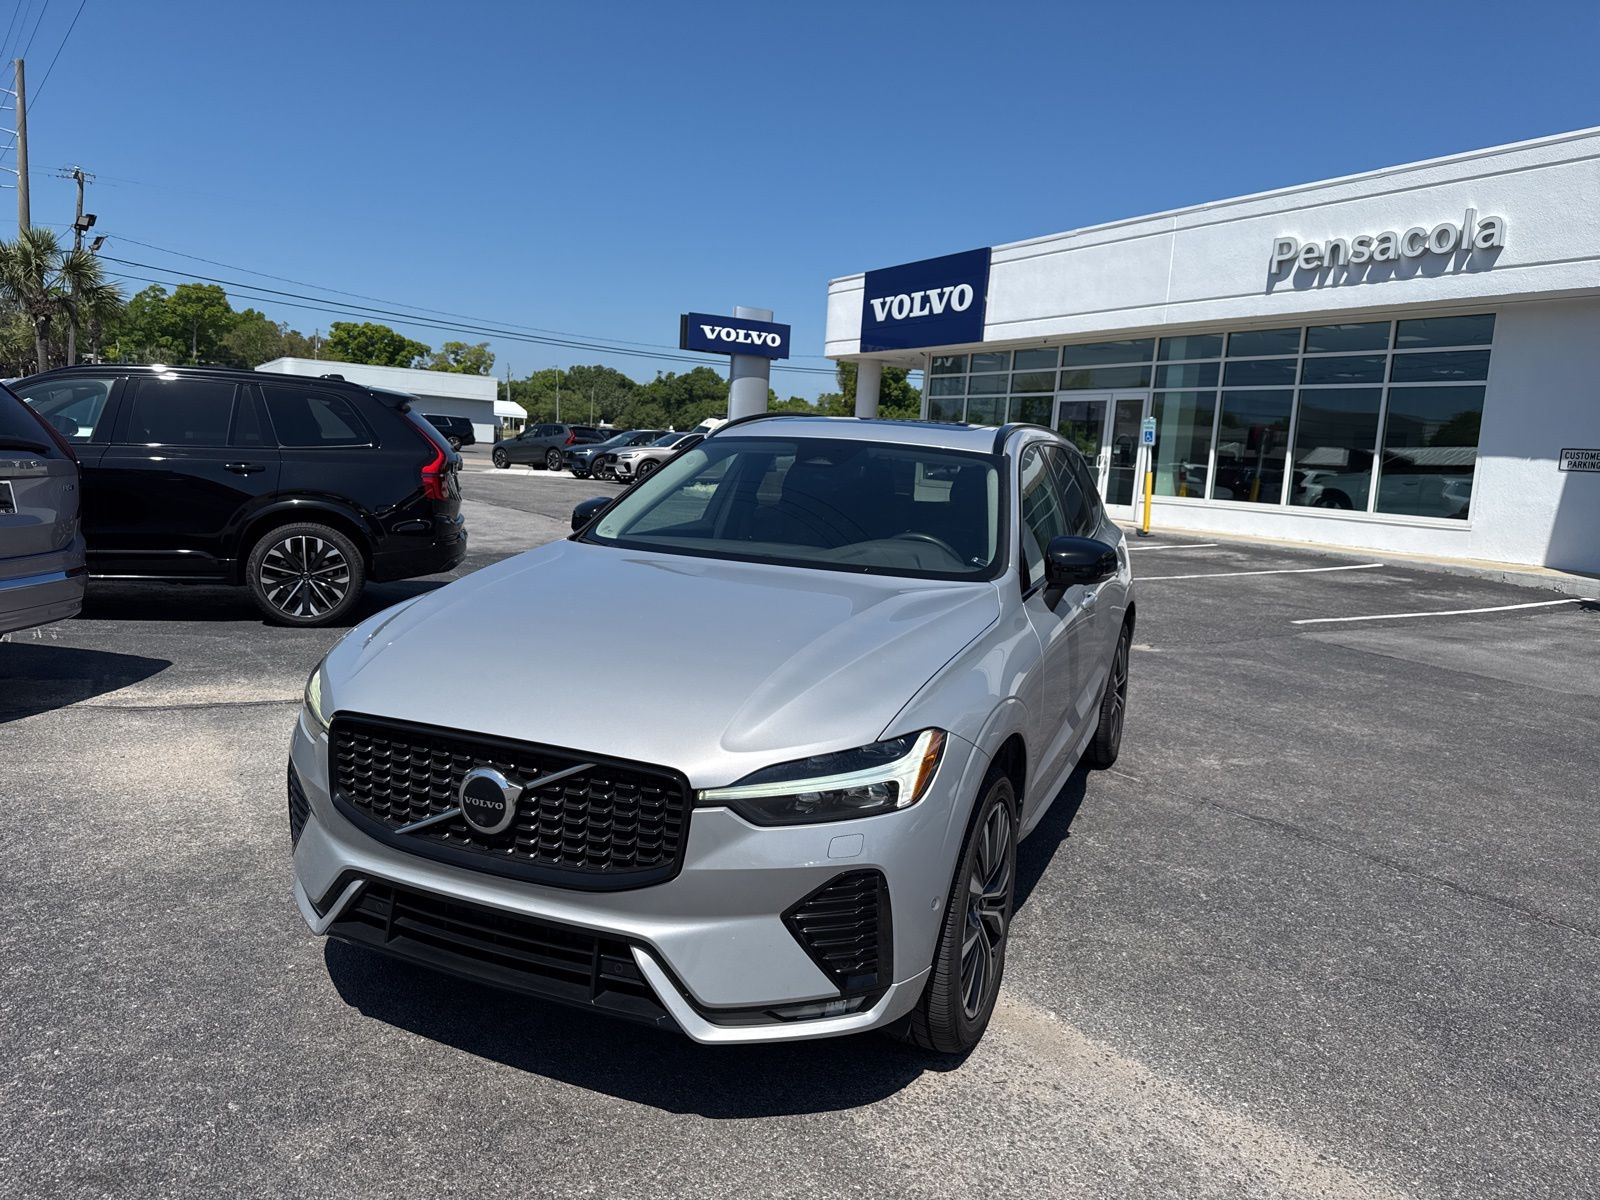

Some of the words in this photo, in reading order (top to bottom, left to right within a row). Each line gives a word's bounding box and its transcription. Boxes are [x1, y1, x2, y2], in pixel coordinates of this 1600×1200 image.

[1270, 208, 1505, 274] Pensacola
[870, 283, 974, 322] VOLVO
[700, 324, 781, 347] VOLVO
[1567, 461, 1600, 469] PARKING
[464, 796, 503, 810] VOLVO
